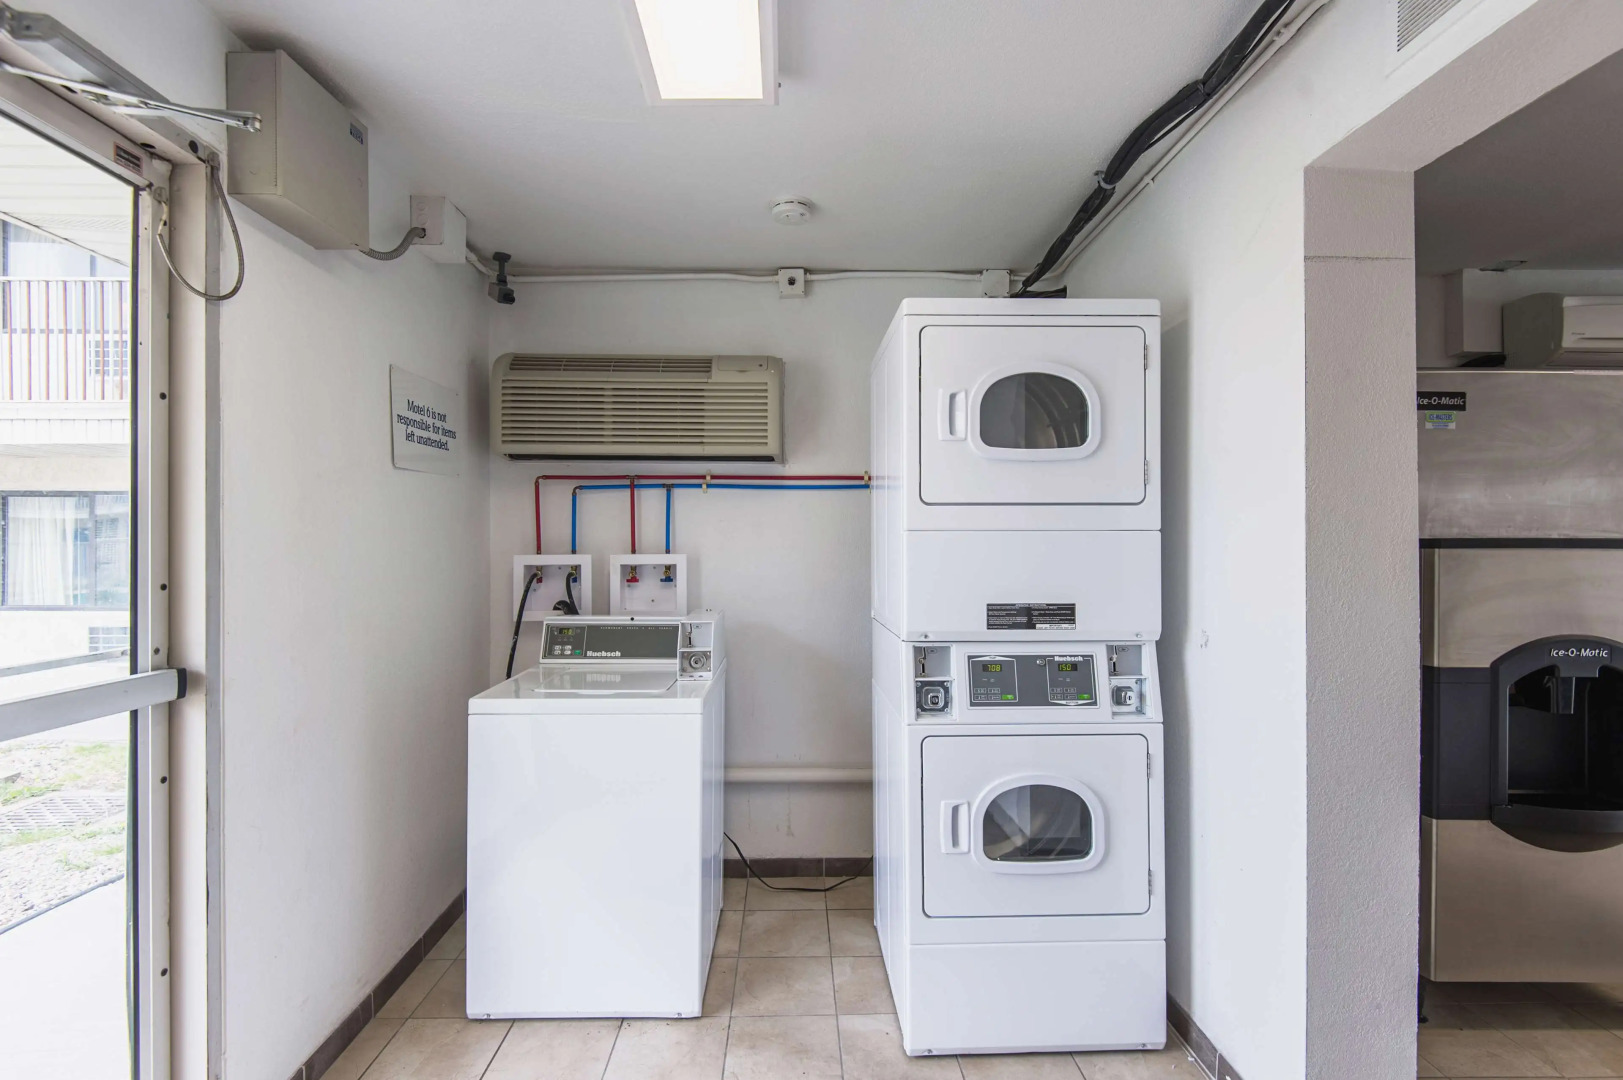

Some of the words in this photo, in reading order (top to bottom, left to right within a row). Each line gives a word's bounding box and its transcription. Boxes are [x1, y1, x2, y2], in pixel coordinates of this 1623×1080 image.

[407, 399, 425, 416] Motel
[426, 406, 431, 418] 6
[431, 407, 437, 420] is
[437, 412, 447, 423] not
[397, 414, 431, 432] responsible
[432, 422, 440, 435] for
[441, 425, 456, 439] items
[405, 428, 415, 443] left
[416, 435, 449, 451] unattended.
[1550, 647, 1609, 657] Ice-O-Matic
